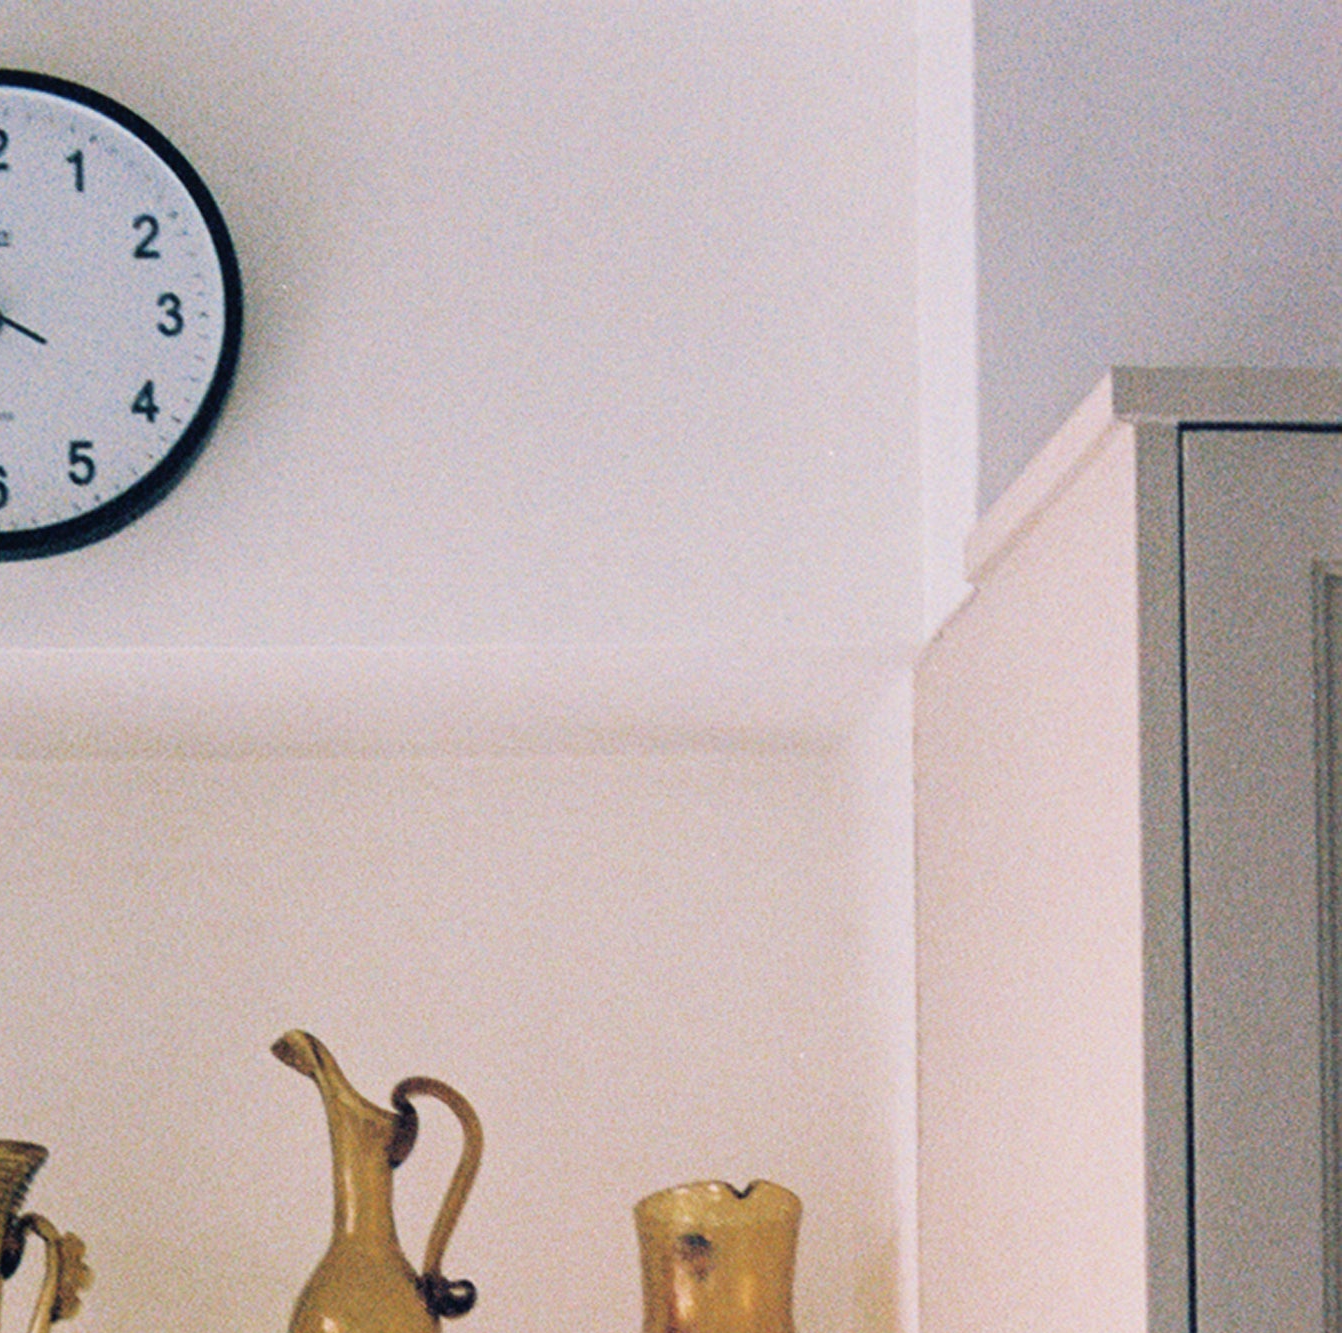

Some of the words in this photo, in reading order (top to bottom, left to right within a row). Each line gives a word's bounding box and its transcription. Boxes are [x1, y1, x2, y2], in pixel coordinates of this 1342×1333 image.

[66, 150, 86, 193] 1
[132, 214, 160, 259] 2
[156, 293, 185, 337] 3
[131, 379, 160, 423] 4
[67, 440, 96, 486] 5
